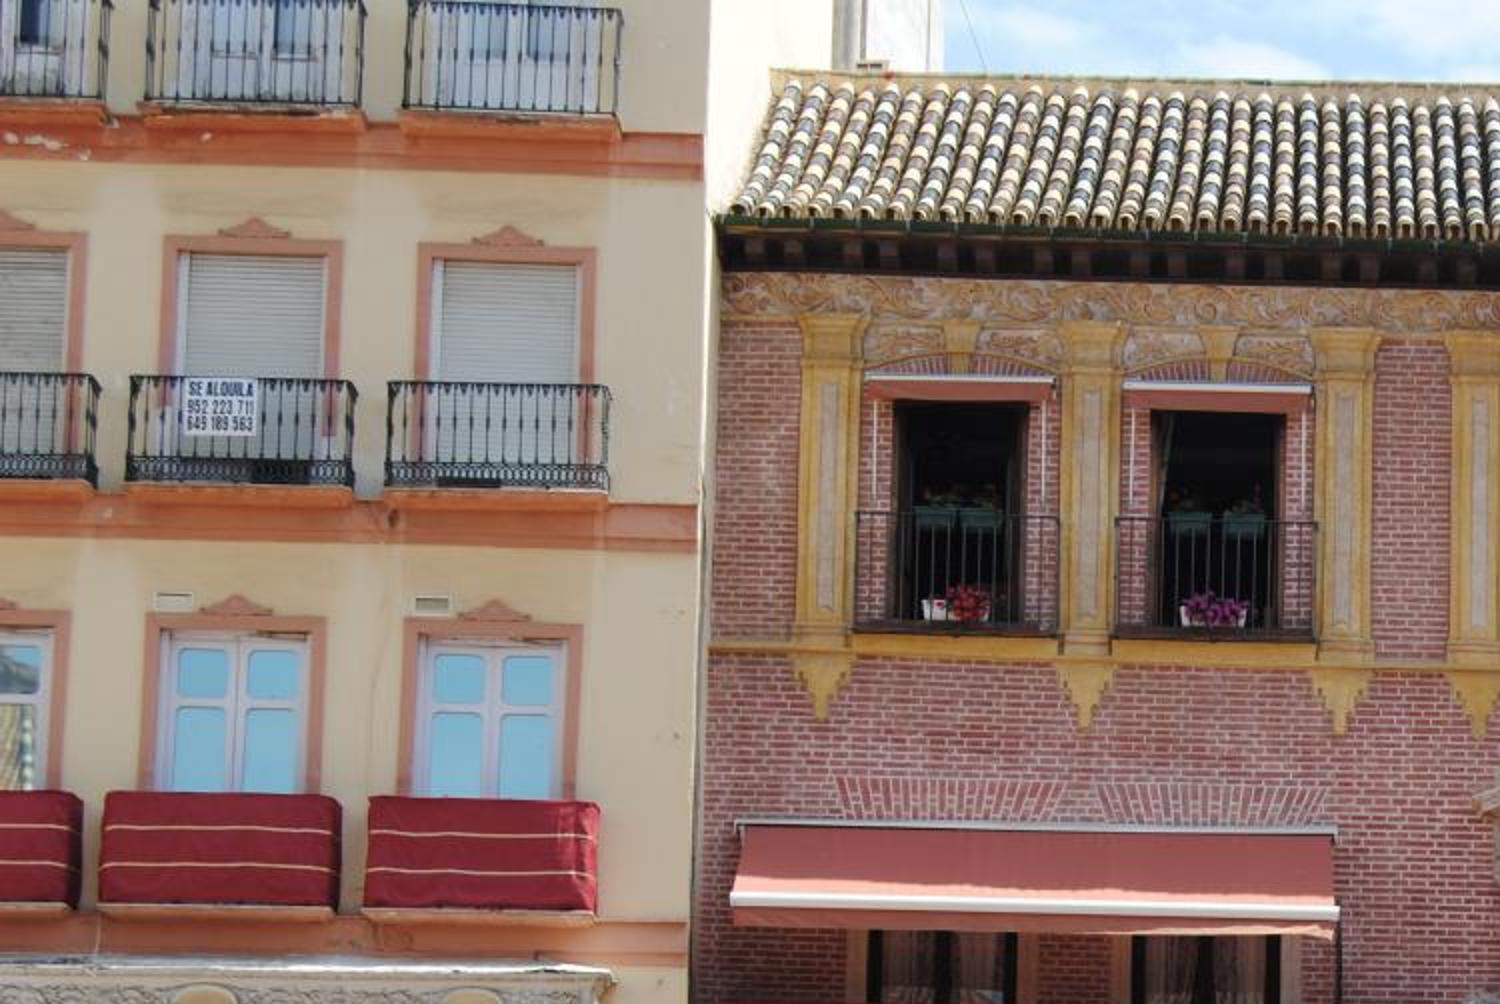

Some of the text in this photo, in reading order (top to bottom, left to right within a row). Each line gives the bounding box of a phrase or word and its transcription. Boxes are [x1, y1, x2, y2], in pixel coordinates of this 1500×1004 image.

[189, 381, 253, 396] SE ALQUILA
[187, 399, 254, 416] 952 223 711
[211, 415, 229, 431] 189
[233, 415, 253, 431] 563
